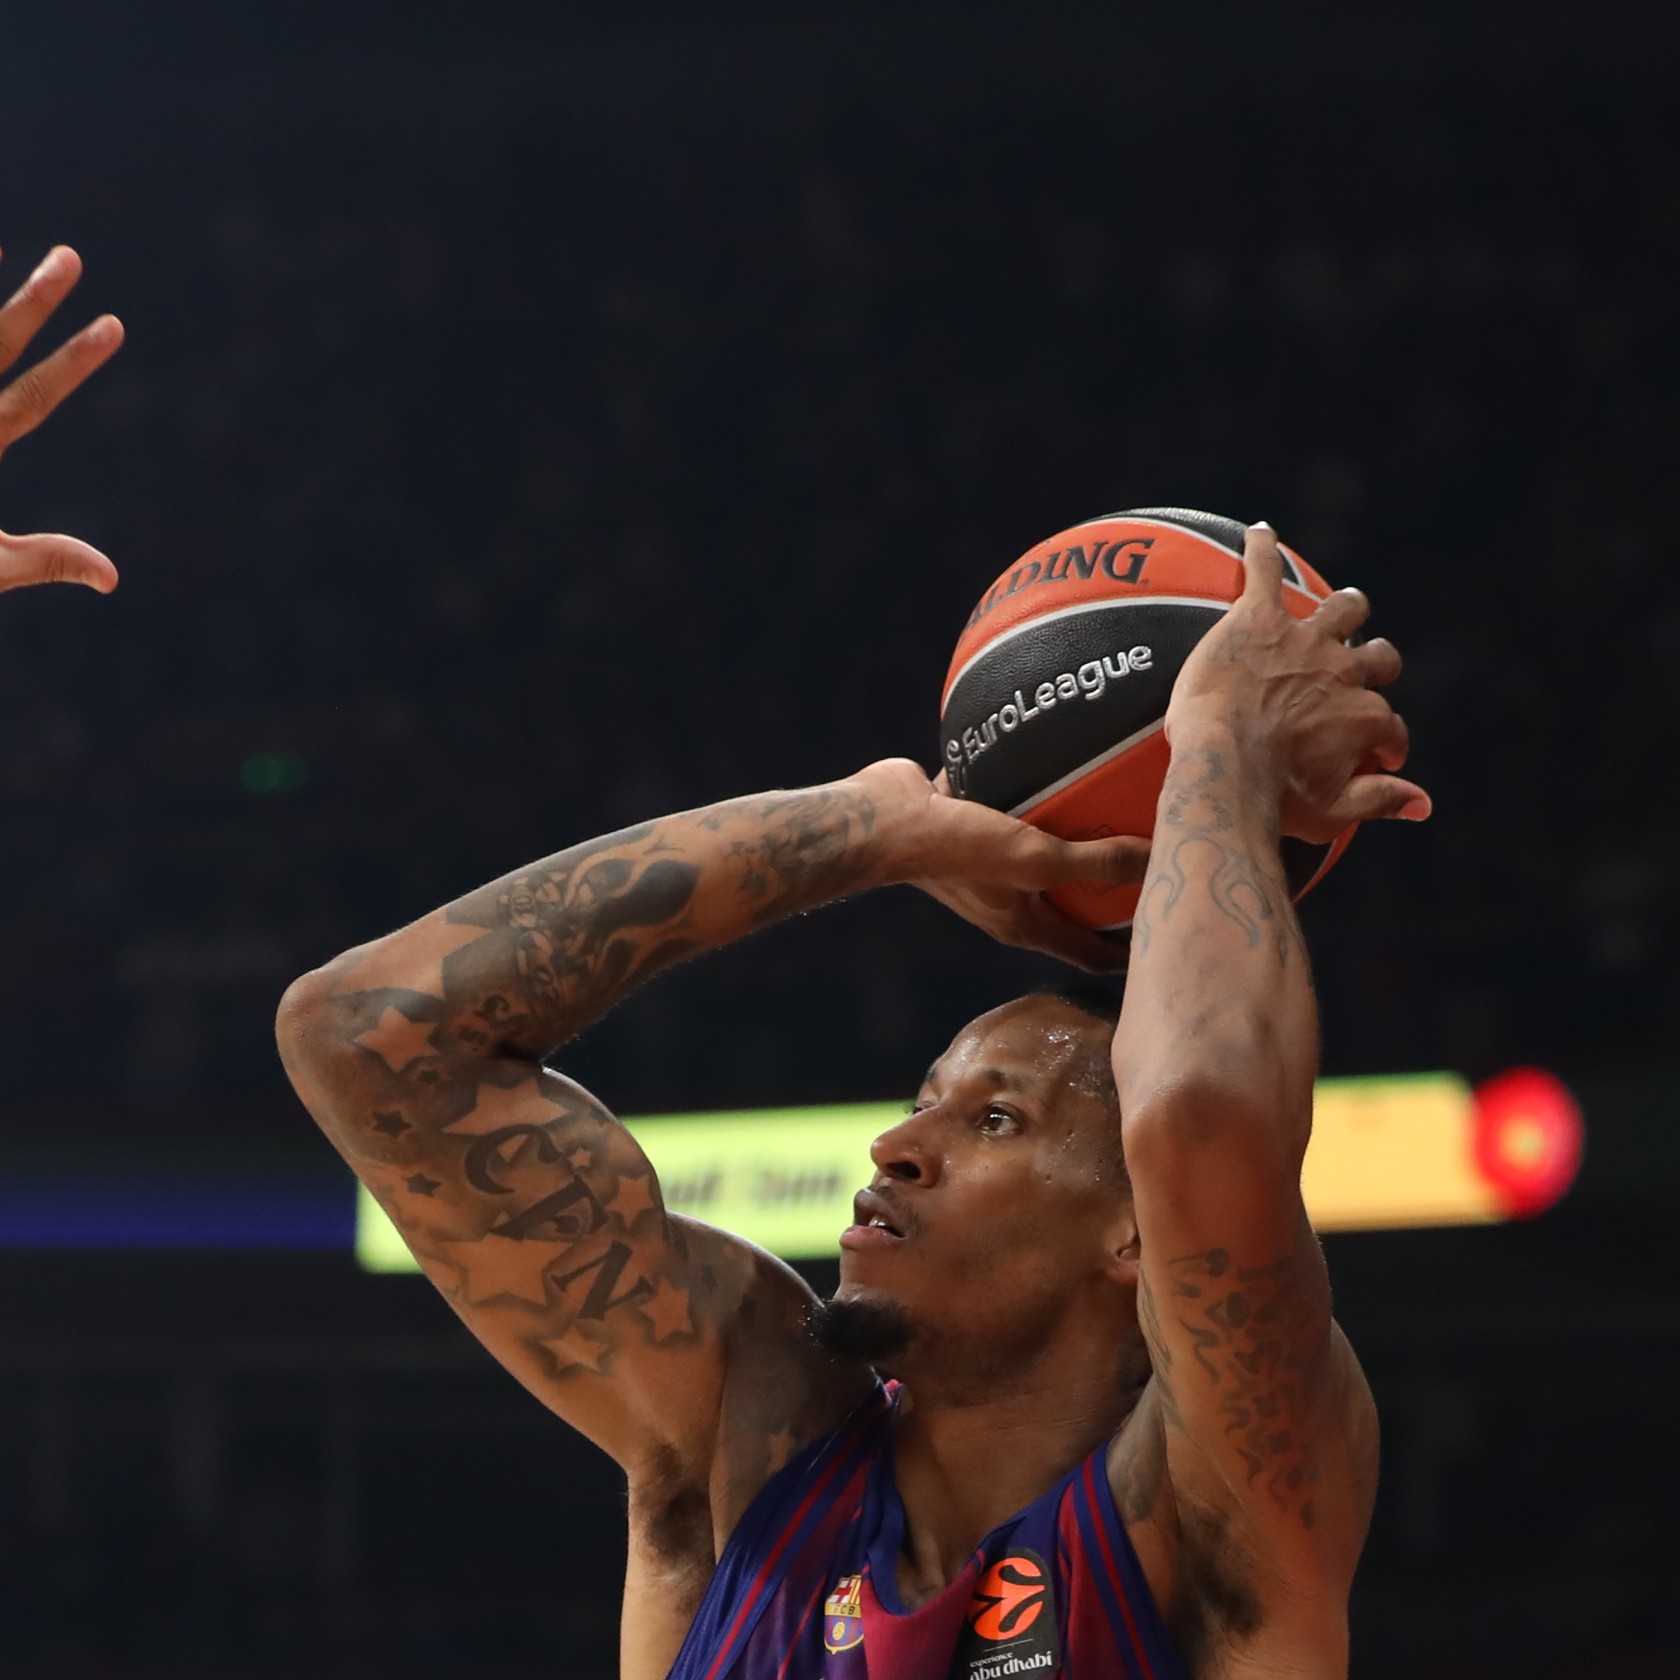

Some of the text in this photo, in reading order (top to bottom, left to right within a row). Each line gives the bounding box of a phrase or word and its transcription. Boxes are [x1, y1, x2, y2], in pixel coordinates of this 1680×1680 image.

[963, 644, 1154, 765] EuroLeague
[833, 1605, 856, 1615] FCB
[1003, 1651, 1052, 1674] dhabi
